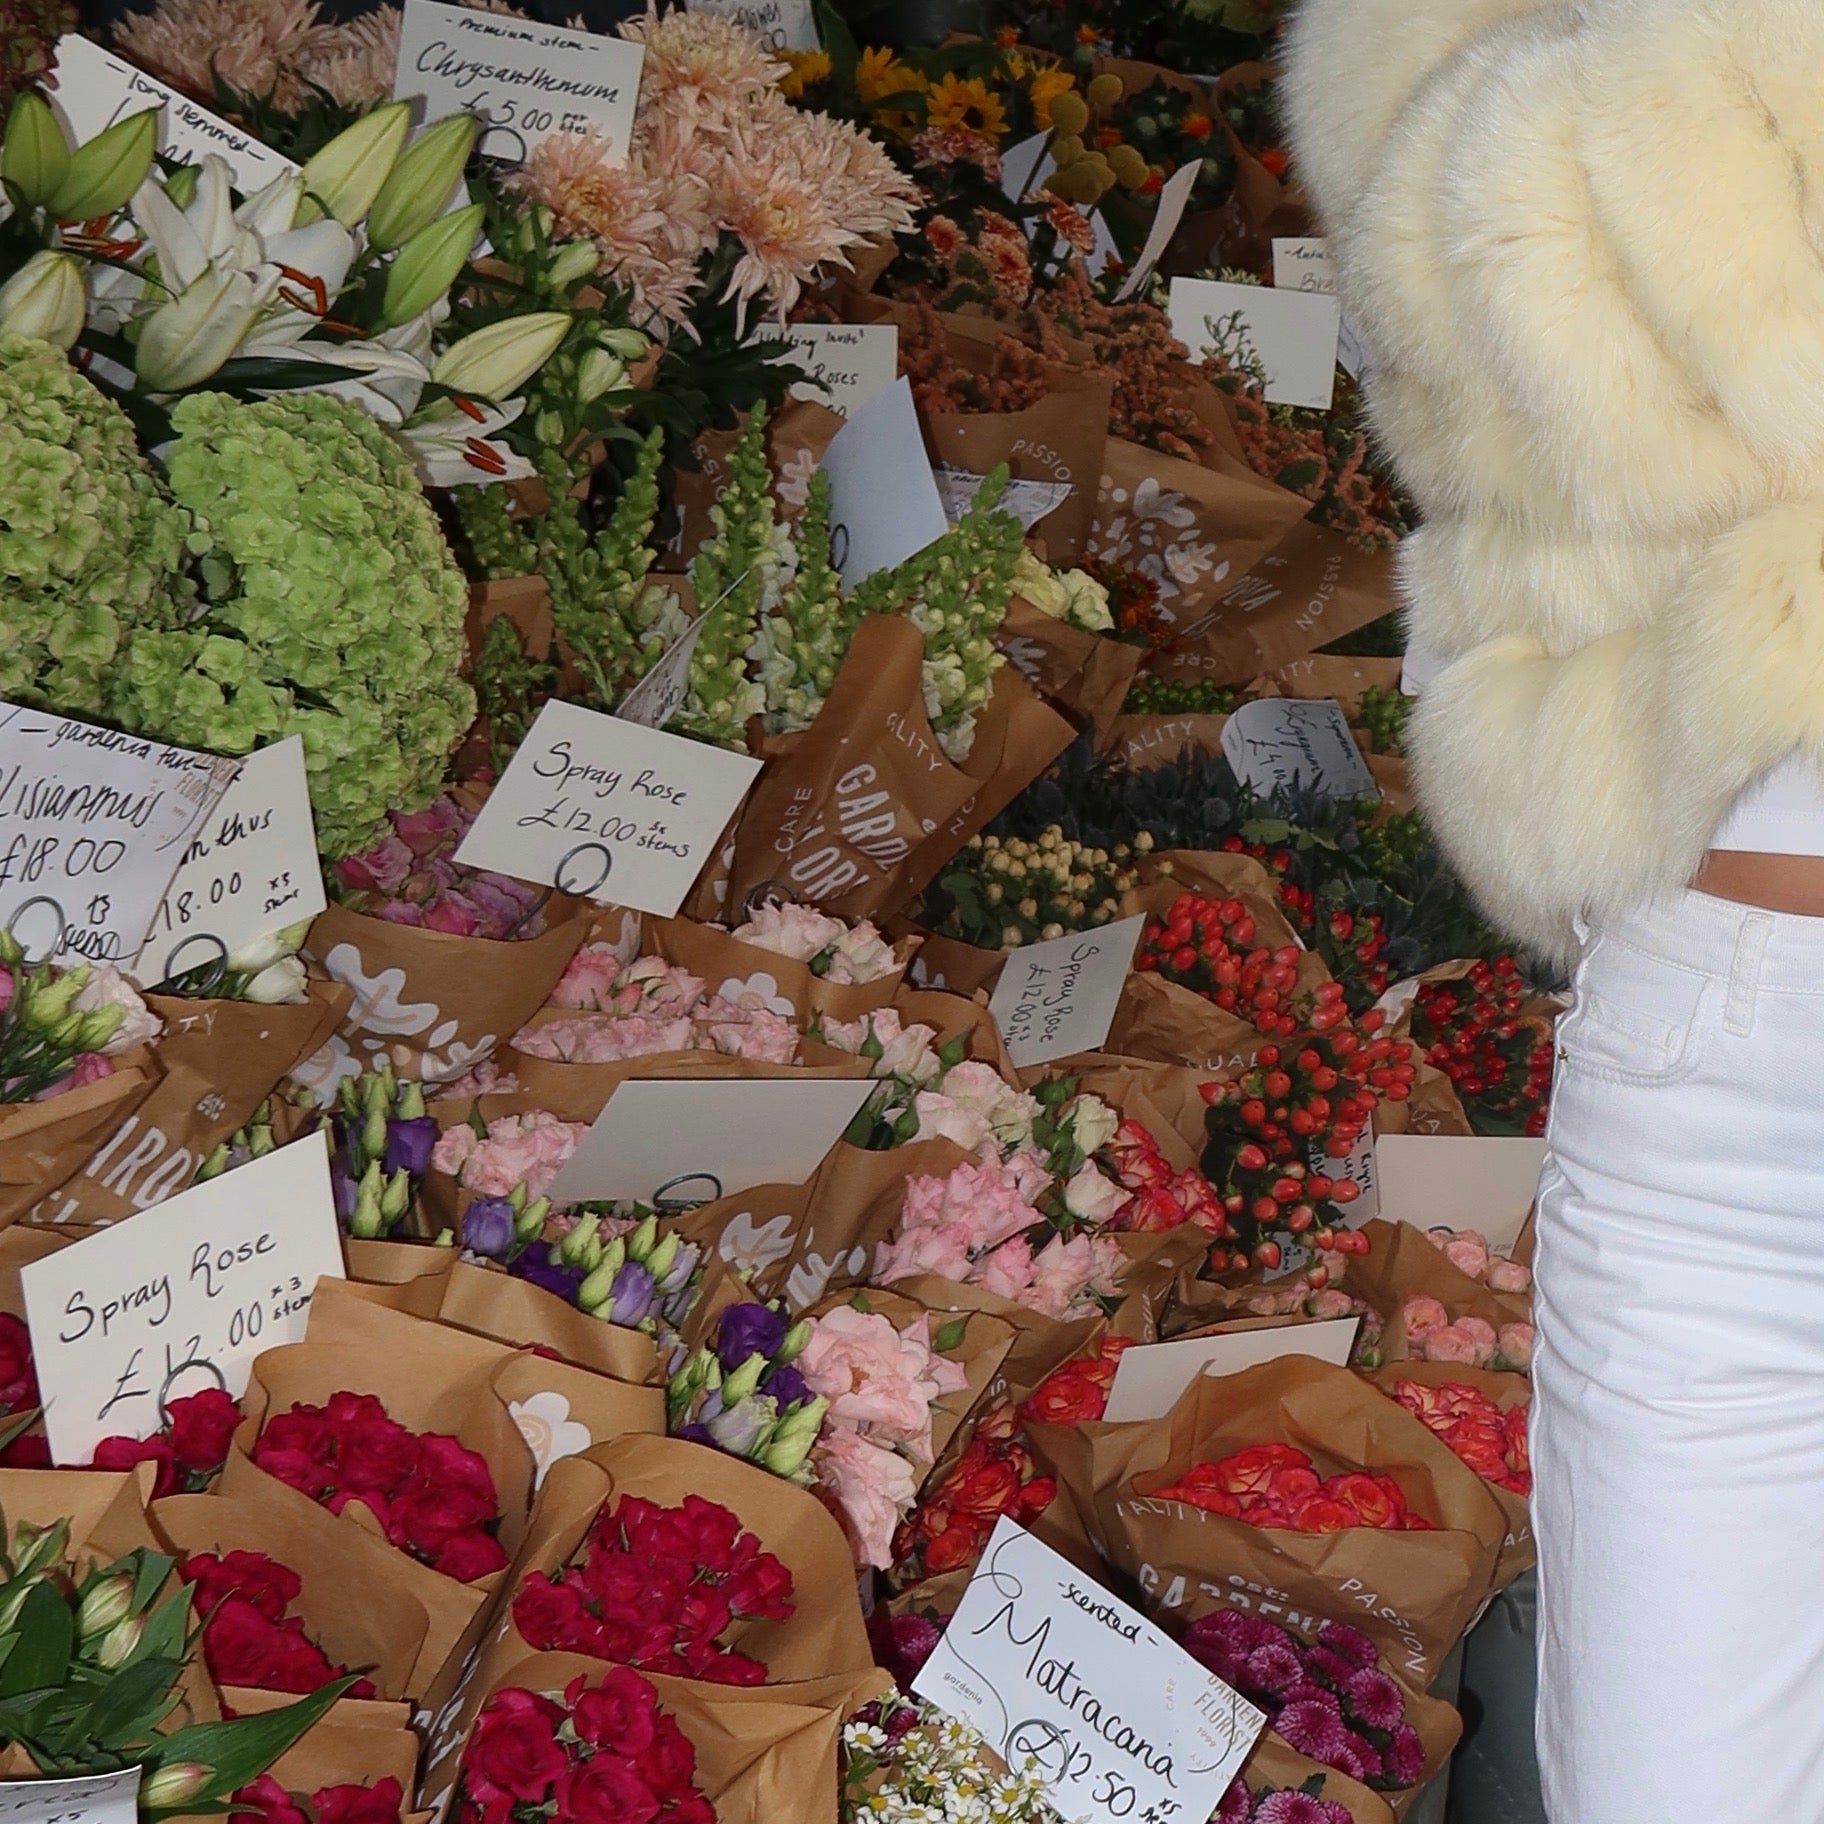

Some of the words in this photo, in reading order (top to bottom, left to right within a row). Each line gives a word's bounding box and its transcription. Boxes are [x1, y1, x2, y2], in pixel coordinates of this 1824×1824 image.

[416, 41, 620, 104] Chrysanthemum
[812, 362, 858, 387] Roses
[1011, 439, 1079, 496] PASSIO
[1296, 555, 1342, 632] PASSION
[532, 741, 622, 798] Spray
[630, 769, 688, 806] Rose
[1109, 720, 1195, 772] ALITY
[516, 796, 637, 842] £12.00
[635, 833, 691, 858] stems
[775, 787, 813, 853] CARE
[146, 871, 243, 942] 18.00
[1042, 942, 1100, 1007] Spray
[1039, 1006, 1074, 1043] Rose
[59, 1274, 172, 1344] Spray
[189, 1233, 277, 1299] Rose
[96, 1301, 263, 1421] £12.00
[1338, 1577, 1428, 1674] PASSION
[943, 1671, 984, 1705] gardenia
[1193, 1691, 1253, 1753] FLORIST
[1015, 1723, 1136, 1817] £12.50
